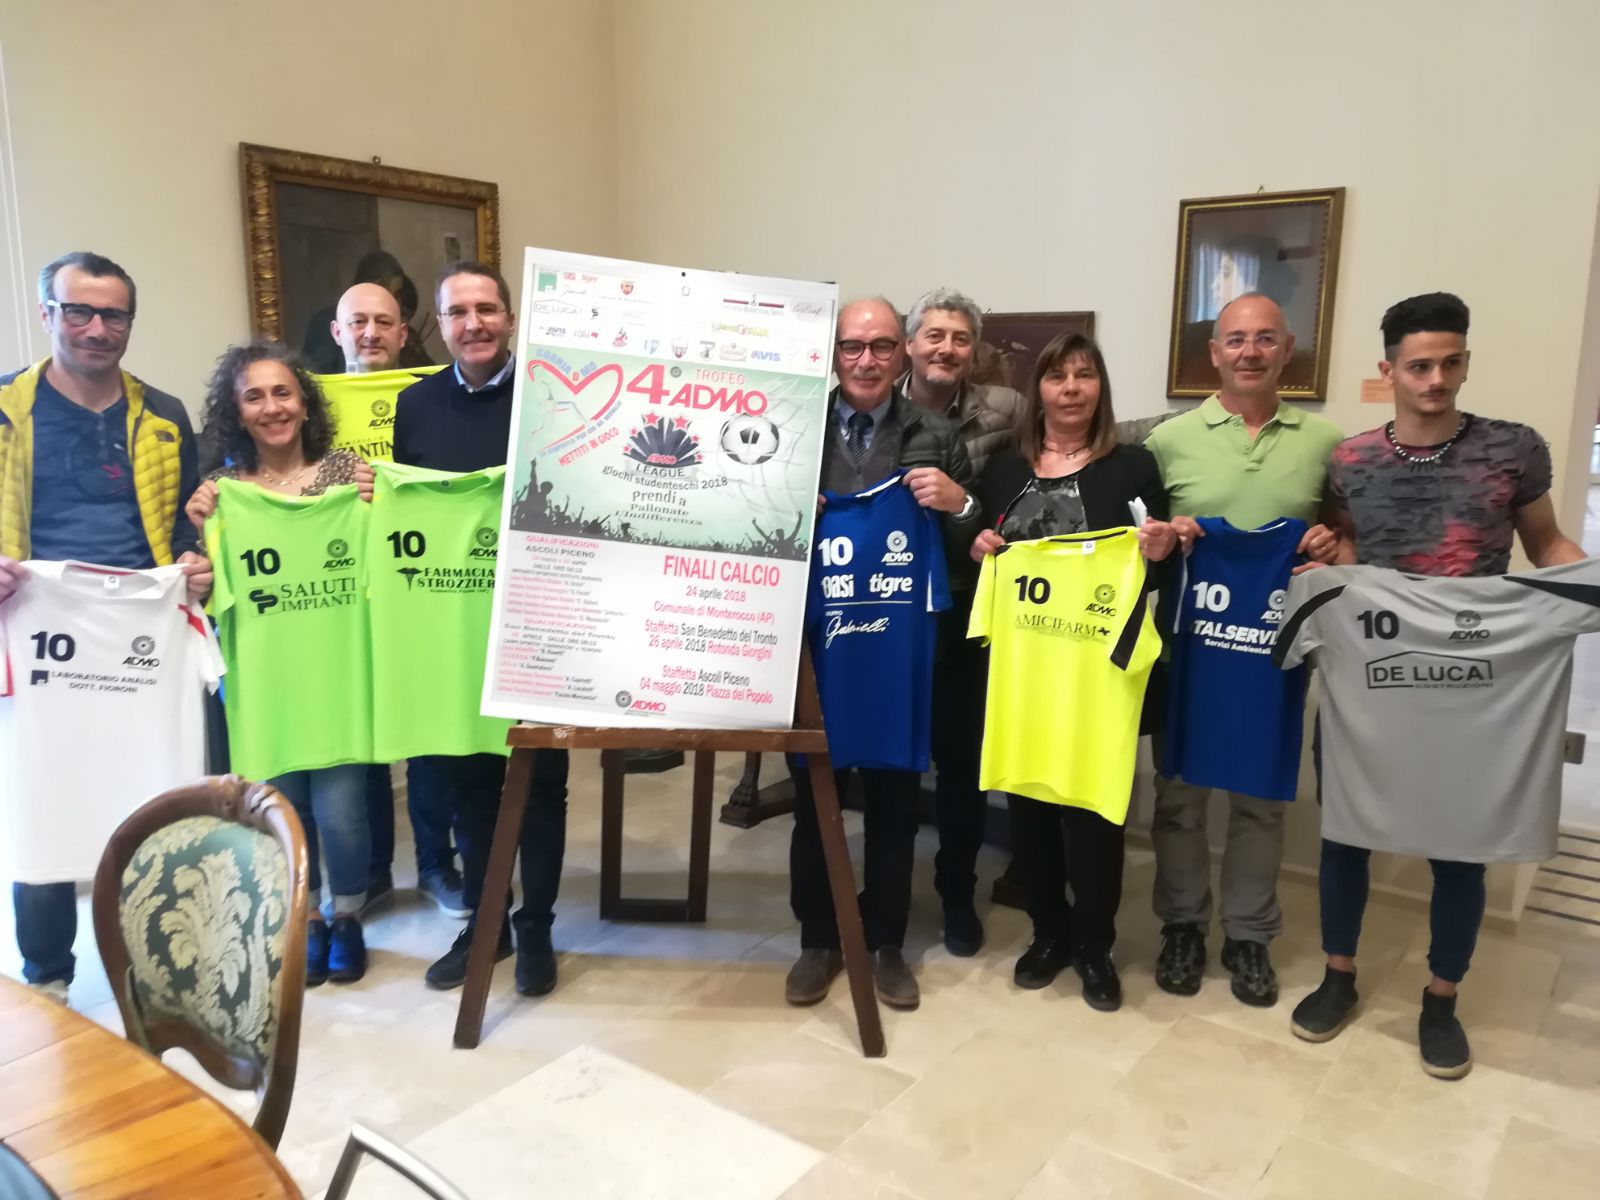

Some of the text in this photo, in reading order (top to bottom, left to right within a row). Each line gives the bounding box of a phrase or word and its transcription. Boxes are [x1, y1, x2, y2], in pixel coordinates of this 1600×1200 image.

[751, 350, 781, 362] AVIS
[626, 363, 746, 405] 4 TROFEO
[668, 383, 768, 416] ADMO
[602, 465, 728, 490] giochi studenteschi 2018
[635, 463, 686, 478] LEAGUE
[630, 503, 690, 516] Pallonate
[679, 497, 687, 506] a
[387, 530, 426, 558] 10
[526, 535, 599, 549] QUALIFICAZIONI
[469, 548, 498, 558] ADM
[525, 545, 595, 559] ASCOLI PICENO
[818, 536, 853, 566] 10
[881, 552, 914, 563] ADMO
[240, 547, 281, 577] 10
[322, 557, 356, 569] ADMO
[424, 567, 496, 578] FARMACIA
[663, 555, 781, 587] FINALI CALCIO
[417, 578, 496, 589] STROZZIER
[869, 572, 913, 598] tigre
[1014, 575, 1050, 605] 10
[686, 585, 746, 602] 24 aprile 2018
[1192, 581, 1231, 613] 10
[654, 601, 696, 616] Comunale
[697, 605, 705, 616] di
[645, 619, 778, 646] Staffetta San Benedetto del Tronto
[1014, 613, 1098, 637] AMICIFARM
[1357, 609, 1399, 640] 10
[1448, 629, 1490, 641] ADMO
[31, 631, 76, 662] 10
[661, 636, 683, 652] aprile
[684, 638, 706, 653] 2018
[742, 644, 774, 662] Giorgini
[1204, 638, 1272, 655] Servizi Ambientali
[122, 656, 160, 668] ADMO
[52, 671, 158, 685] LABORATORIO ANALISI
[662, 665, 751, 687] Staffetta Ascoli Piceno
[1372, 665, 1485, 682] DE LUCA
[640, 677, 774, 704] 04 maggio 2018 Piazza del Popolo
[630, 700, 667, 712] ADMO
